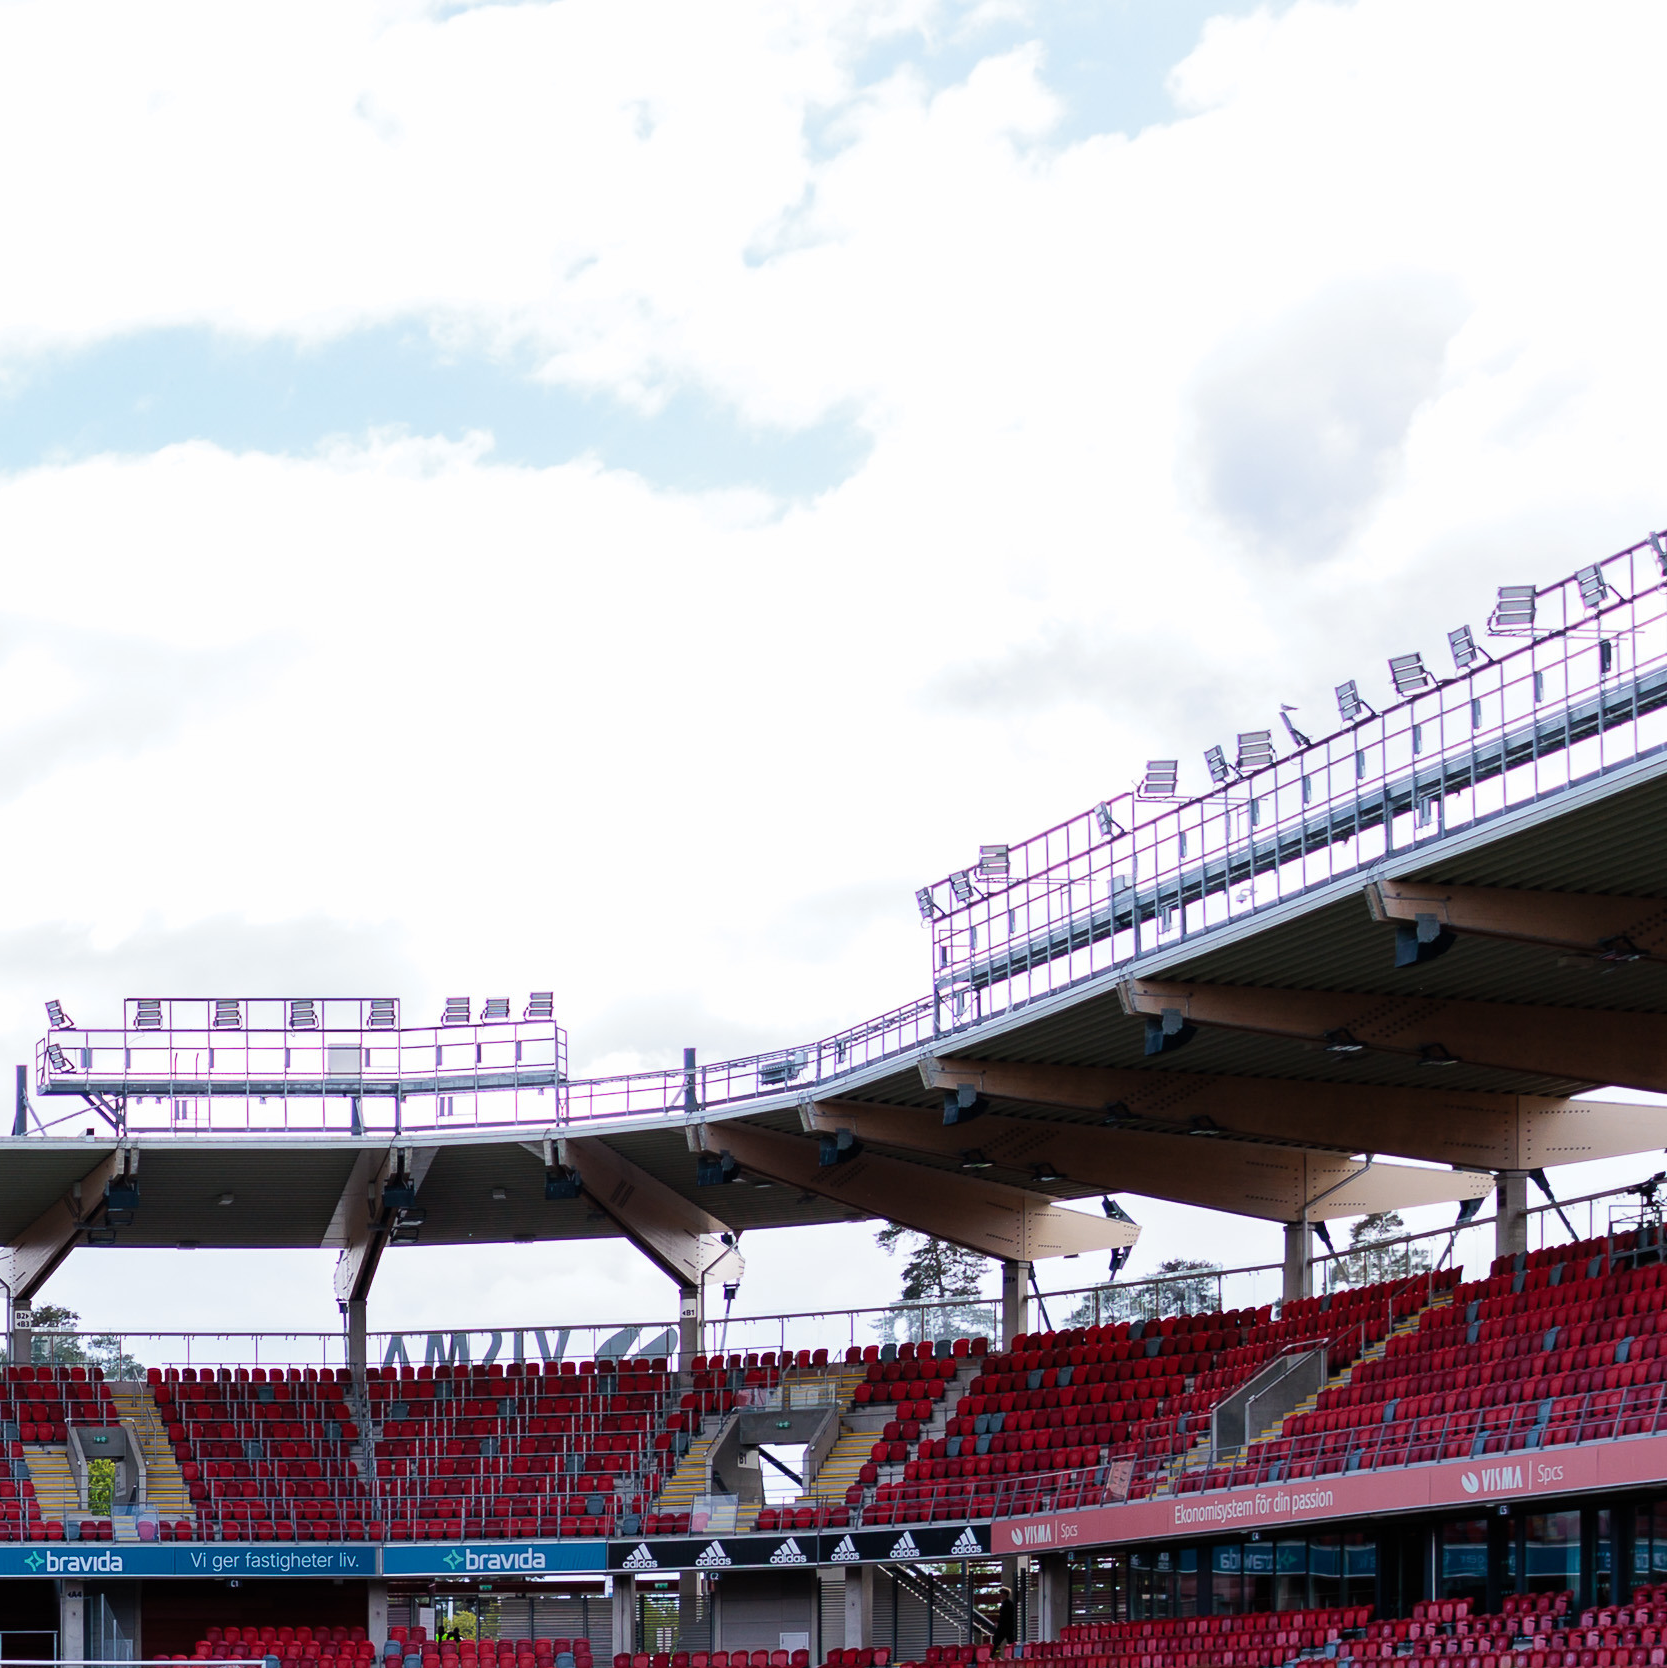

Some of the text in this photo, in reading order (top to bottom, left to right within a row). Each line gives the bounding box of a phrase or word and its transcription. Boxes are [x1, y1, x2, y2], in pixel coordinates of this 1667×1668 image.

[1481, 1463, 1563, 1492] VISMA Spcs
[1174, 1488, 1334, 1525] Ekonomisystem för din passion
[1023, 1522, 1078, 1545] VISMA Spcs
[830, 1550, 860, 1561] adidas
[889, 1547, 920, 1559] adidas
[951, 1543, 982, 1555] adidas
[46, 1550, 123, 1572] bravida
[190, 1551, 359, 1572] Vi ger fastigheter liv.
[466, 1548, 546, 1570] bravida
[622, 1557, 658, 1569] adidas
[695, 1554, 732, 1567] adidas
[769, 1552, 807, 1564] adidas
